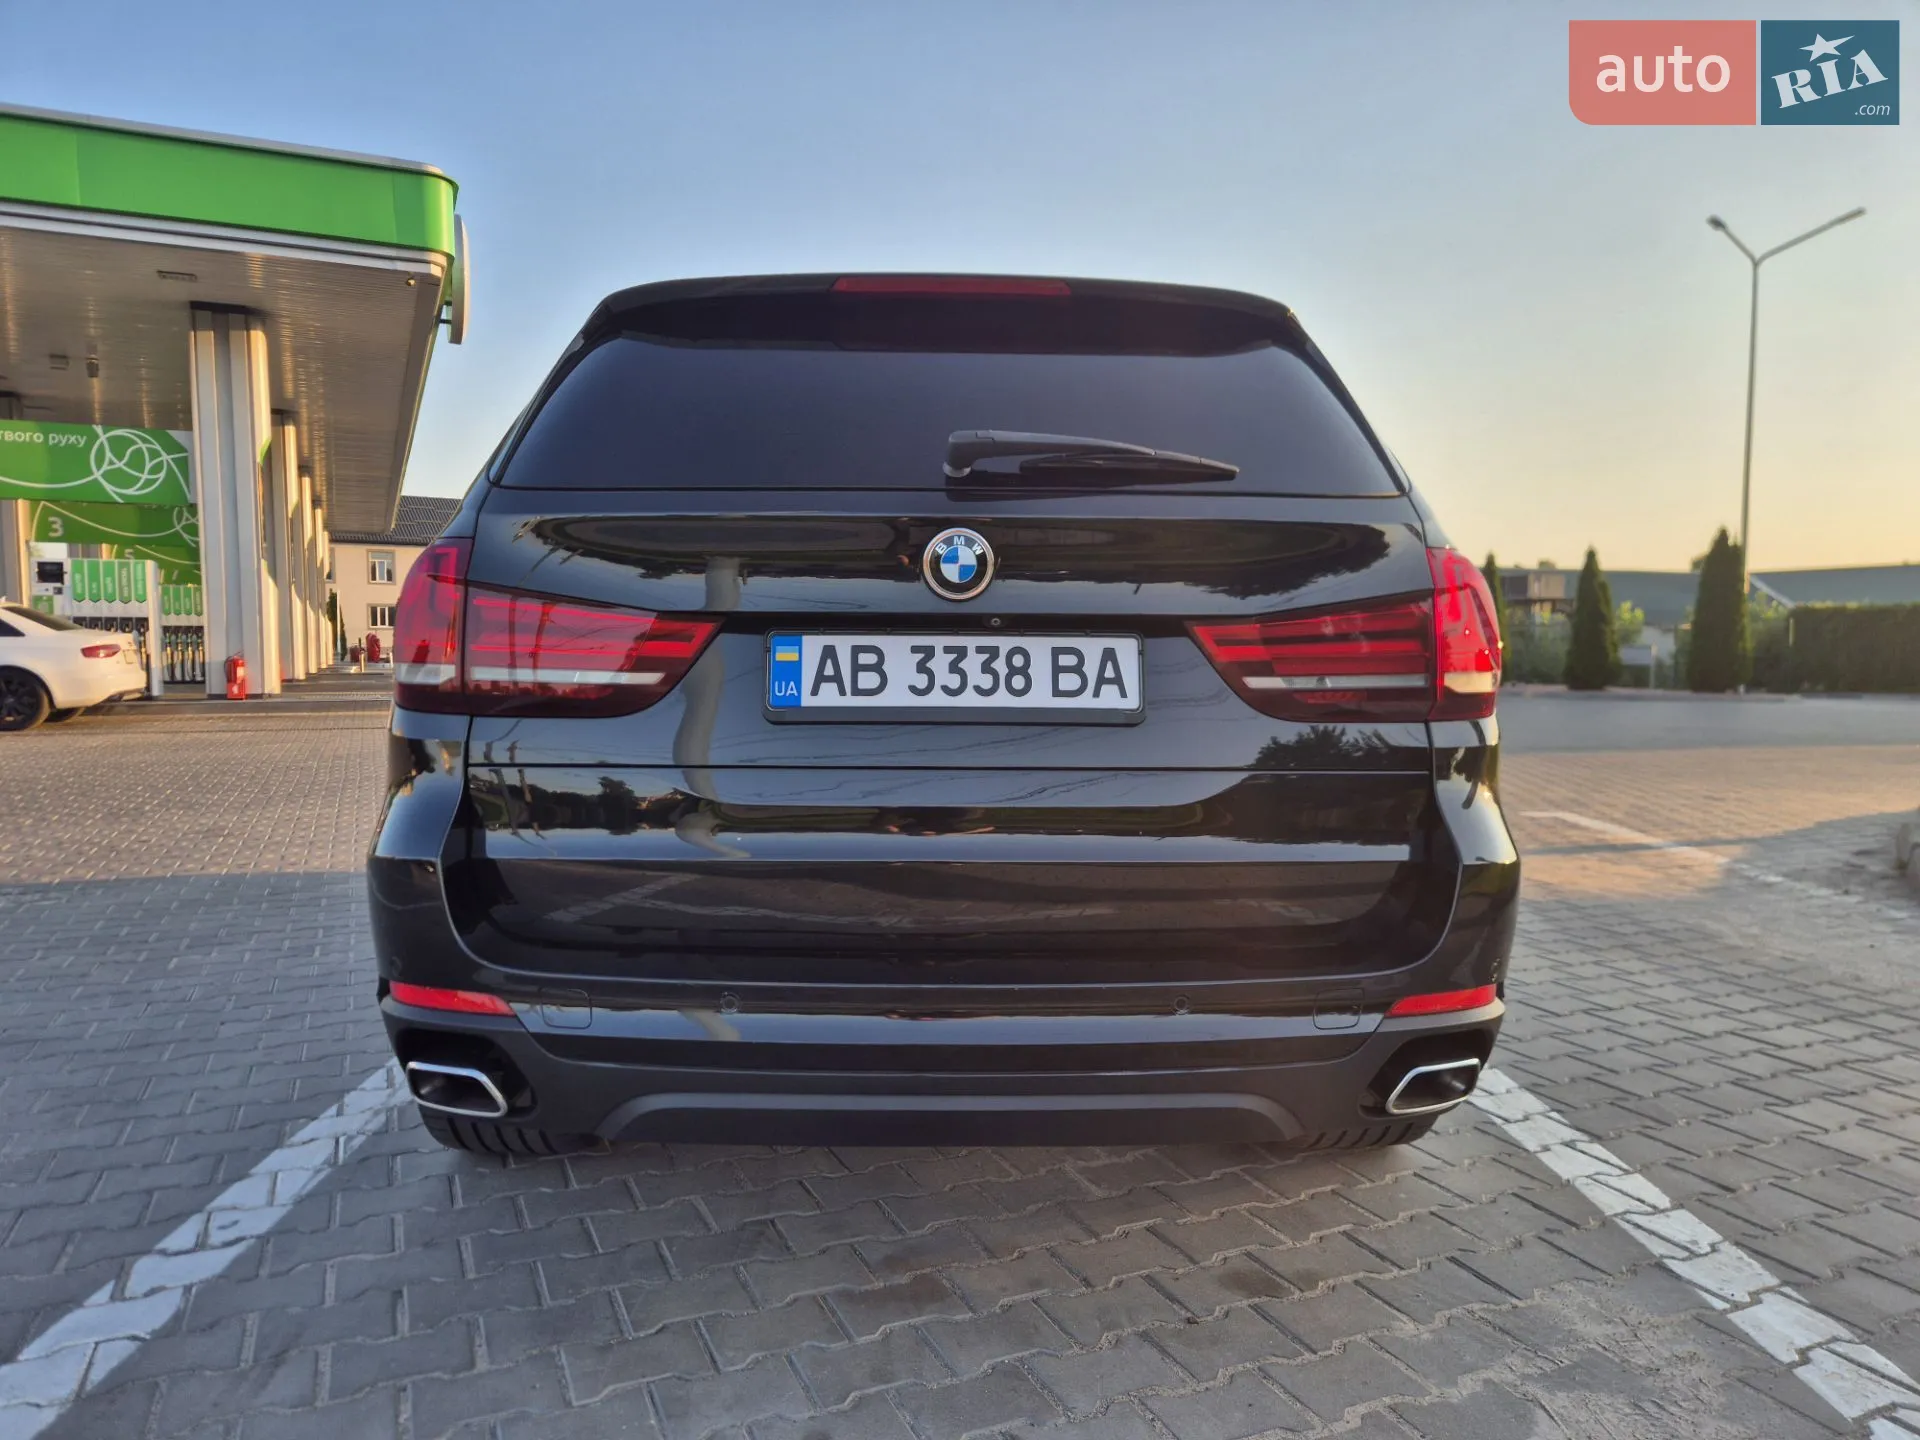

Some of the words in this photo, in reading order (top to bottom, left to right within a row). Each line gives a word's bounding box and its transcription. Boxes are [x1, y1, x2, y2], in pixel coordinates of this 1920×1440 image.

[48, 433, 87, 447] руху
[48, 517, 64, 537] 3
[935, 535, 984, 555] BMW
[810, 644, 888, 697] AB
[908, 645, 1033, 698] 3338
[1051, 646, 1128, 699] BA
[775, 681, 798, 697] UA
